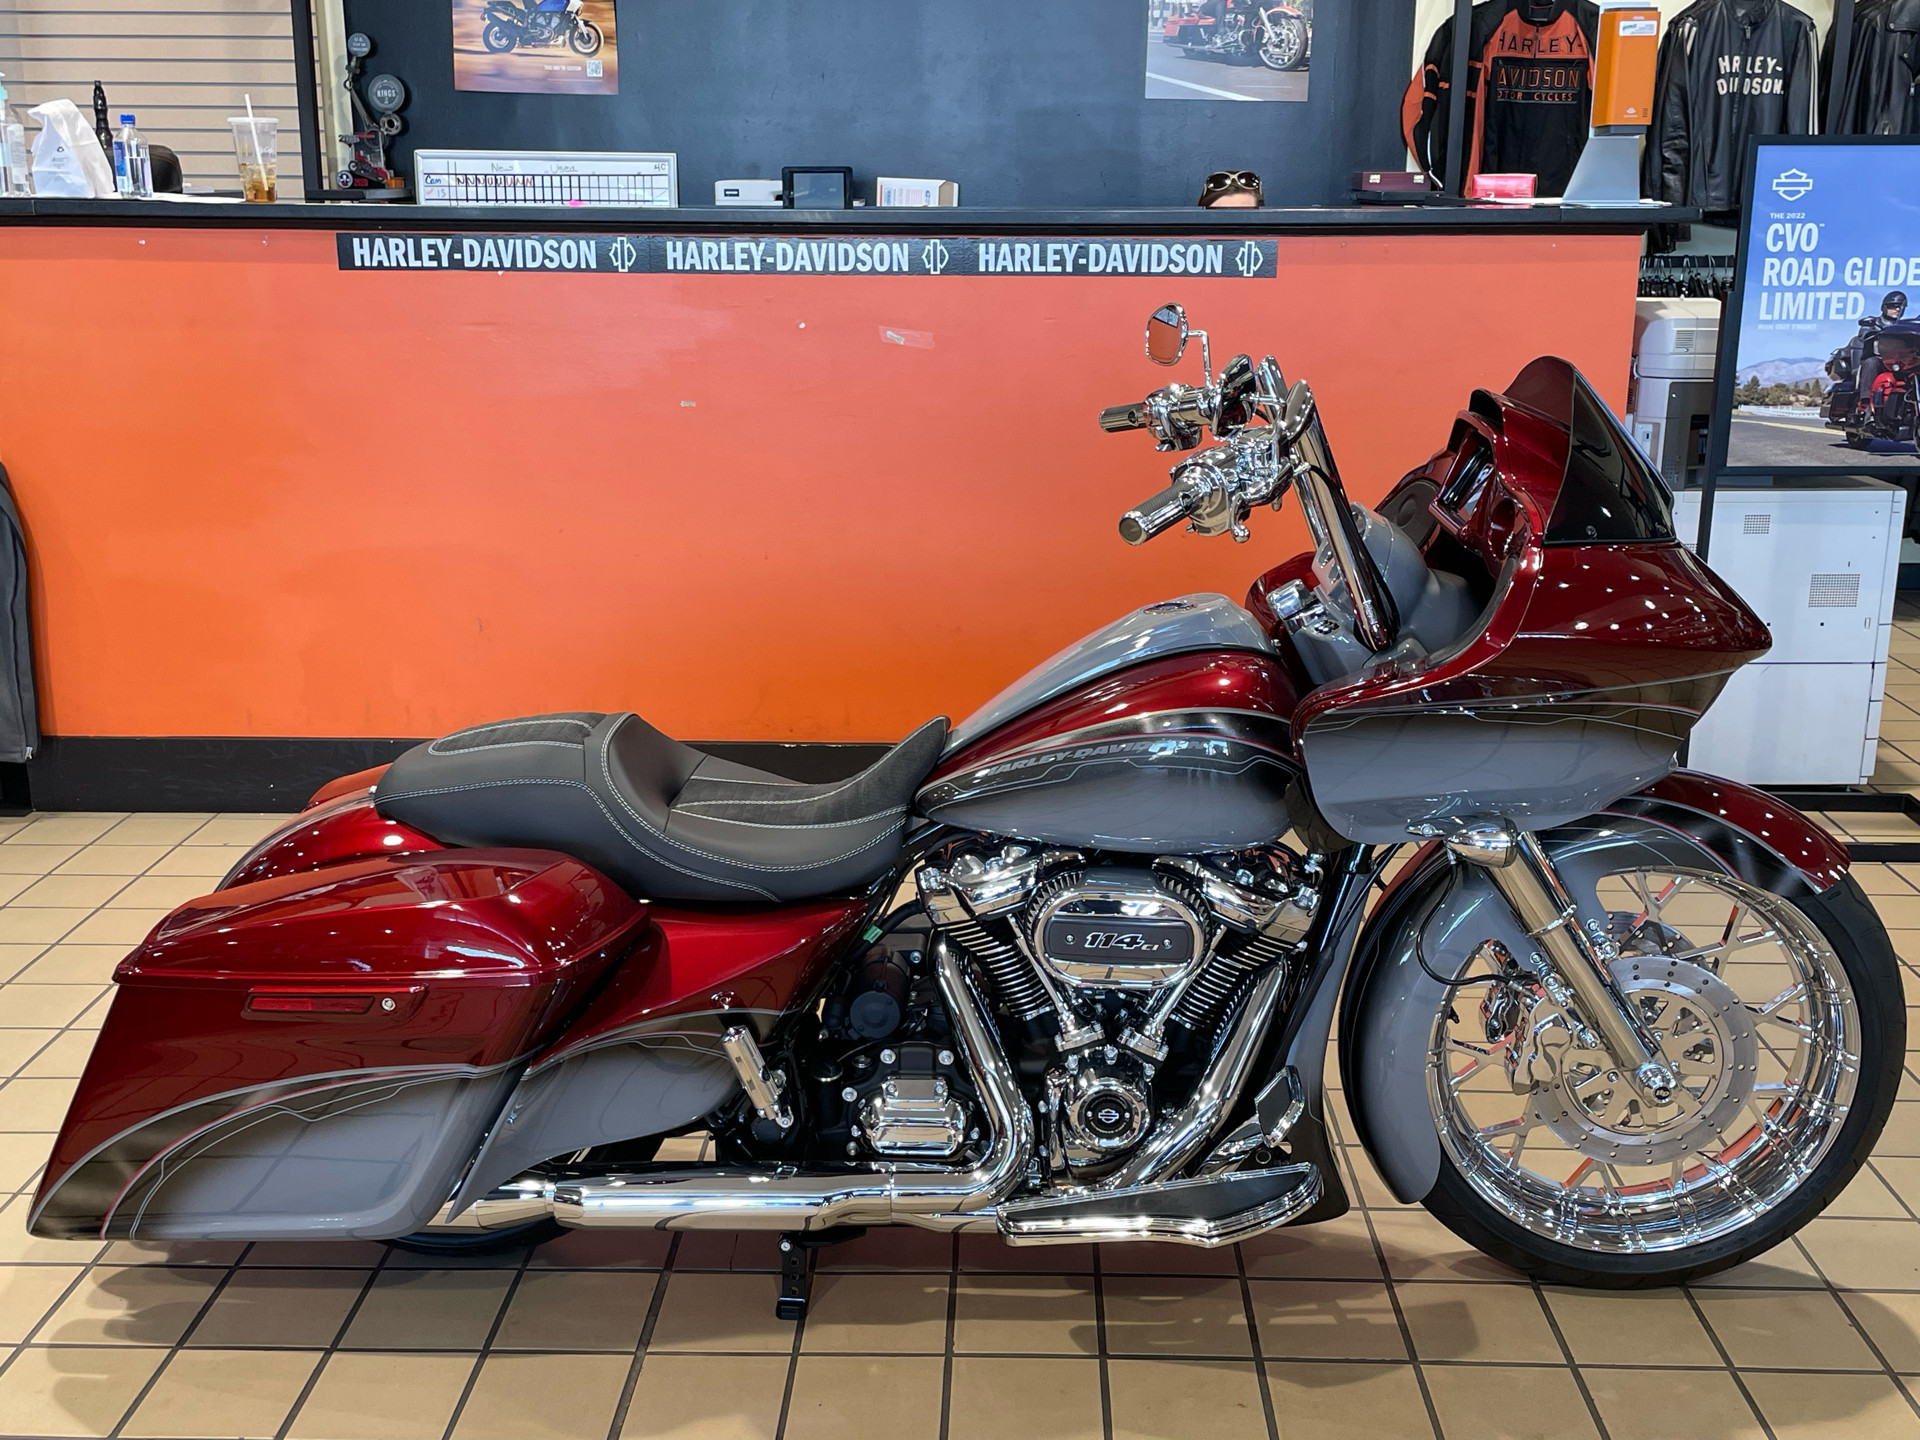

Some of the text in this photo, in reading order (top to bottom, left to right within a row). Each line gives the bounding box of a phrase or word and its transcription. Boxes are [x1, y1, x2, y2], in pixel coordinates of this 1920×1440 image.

[1497, 66, 1579, 88] AVIDSON
[376, 89, 396, 98] KINGS
[1497, 90, 1573, 101] OTOR CYCLES
[352, 237, 598, 269] HARLEY-DAVIDSON
[666, 240, 909, 272] HARLEY-DAVIDSON
[978, 243, 1224, 274] HARLEY-DAVIDSON
[1762, 257, 1920, 287] ROAD GLIDE
[1759, 291, 1865, 321] LIMITED
[1084, 932, 1146, 950] 114
